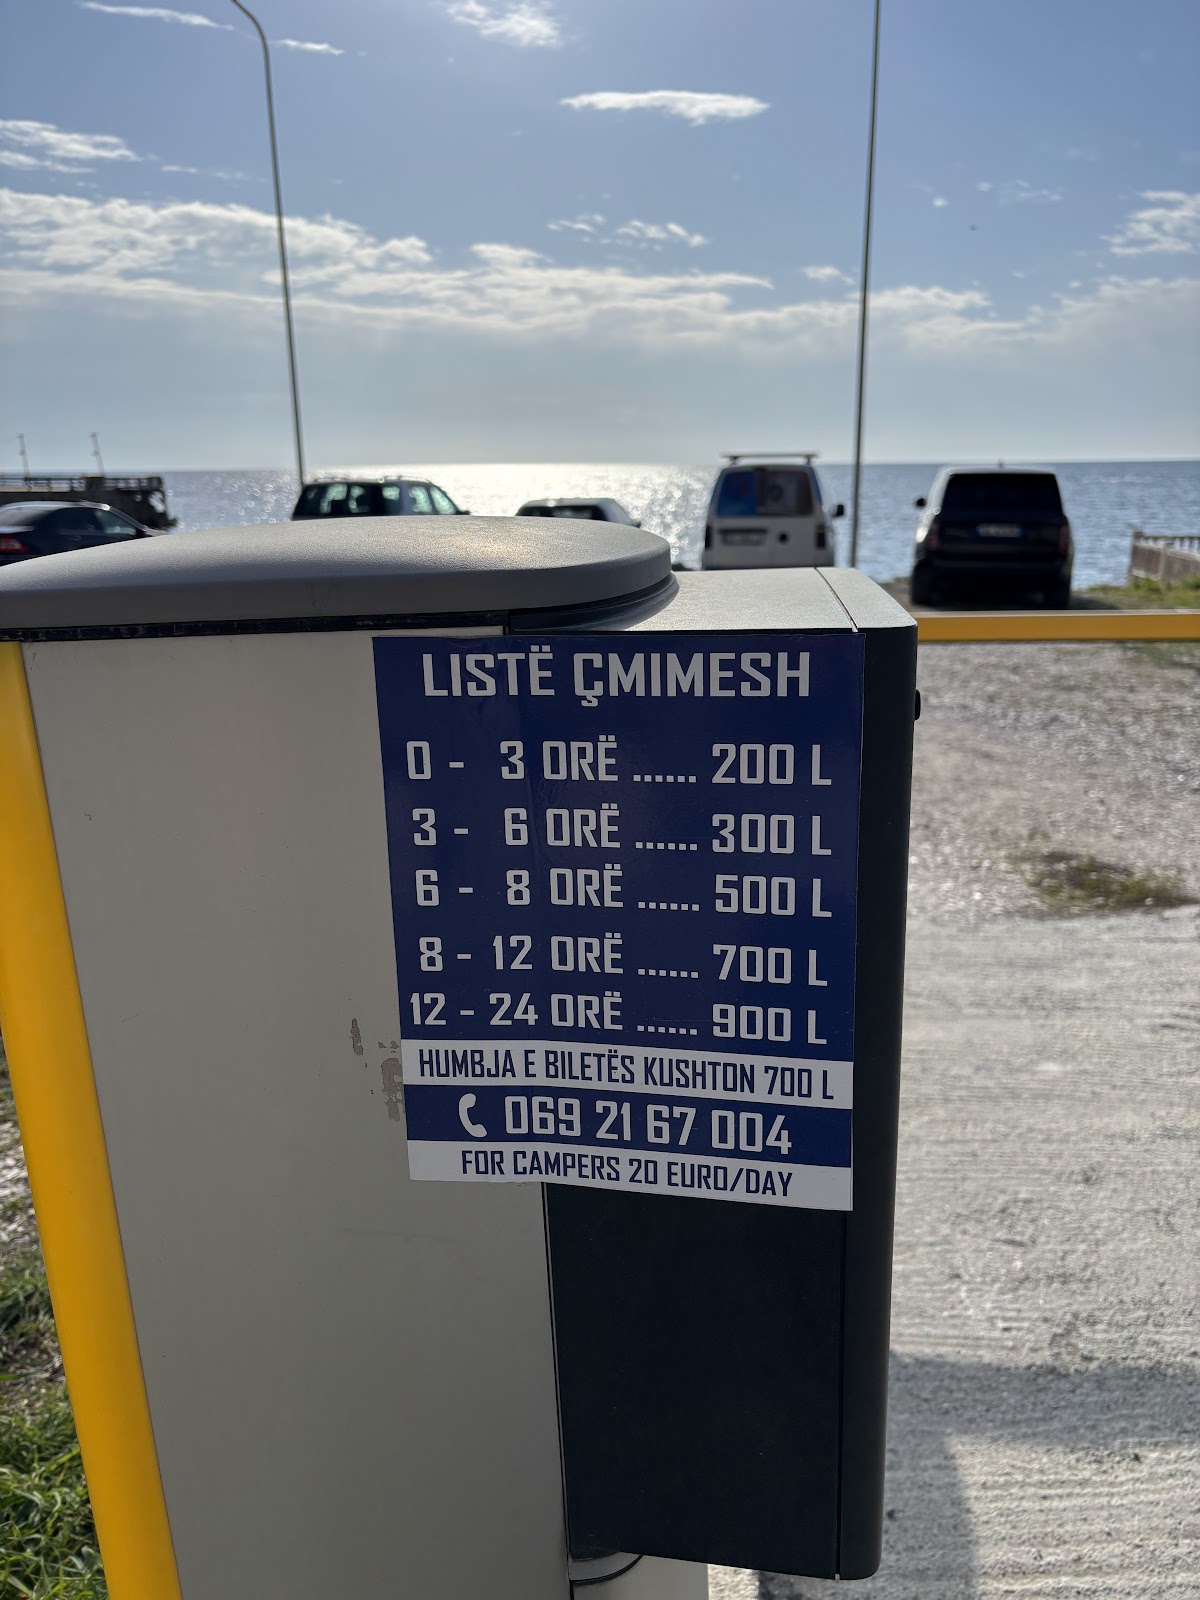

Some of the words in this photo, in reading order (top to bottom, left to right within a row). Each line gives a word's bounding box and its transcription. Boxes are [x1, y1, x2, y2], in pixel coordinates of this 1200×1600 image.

[422, 645, 555, 696] LISTË
[574, 652, 810, 707] ÇMIMESH
[406, 741, 431, 780] 0
[500, 741, 525, 780] 3
[542, 735, 618, 782] ORË
[711, 743, 794, 785] 200
[812, 744, 831, 785] L
[412, 808, 436, 846] 3
[504, 808, 528, 846] 6
[546, 803, 620, 848] ORË
[712, 813, 794, 854] 300
[812, 816, 831, 855] L
[416, 869, 439, 906] 6
[506, 869, 530, 906] 8
[550, 863, 623, 908] ORË
[715, 874, 795, 916] 500
[812, 878, 832, 917] L
[419, 937, 443, 972] 8
[493, 935, 532, 970] 12
[551, 933, 623, 974] ORË
[712, 944, 791, 984] 700
[808, 949, 827, 986] L
[410, 992, 446, 1026] 12
[489, 992, 538, 1026] 24
[551, 991, 623, 1030] ORË
[712, 1003, 791, 1042] 900
[808, 1010, 827, 1044] L
[419, 1049, 516, 1078] HUMBJA
[525, 1050, 536, 1078] E
[545, 1049, 635, 1084] BILETËS
[644, 1057, 755, 1094] KUSHTON
[764, 1066, 812, 1098] 700
[822, 1070, 834, 1100] L
[505, 1096, 581, 1137] 069
[596, 1101, 631, 1141] 21
[646, 1104, 696, 1146] 67
[711, 1109, 792, 1155] 004
[461, 1150, 504, 1175] FOR
[513, 1150, 619, 1181] CAMPERS
[629, 1158, 658, 1184] 20
[668, 1162, 792, 1198] EURO/DAY
